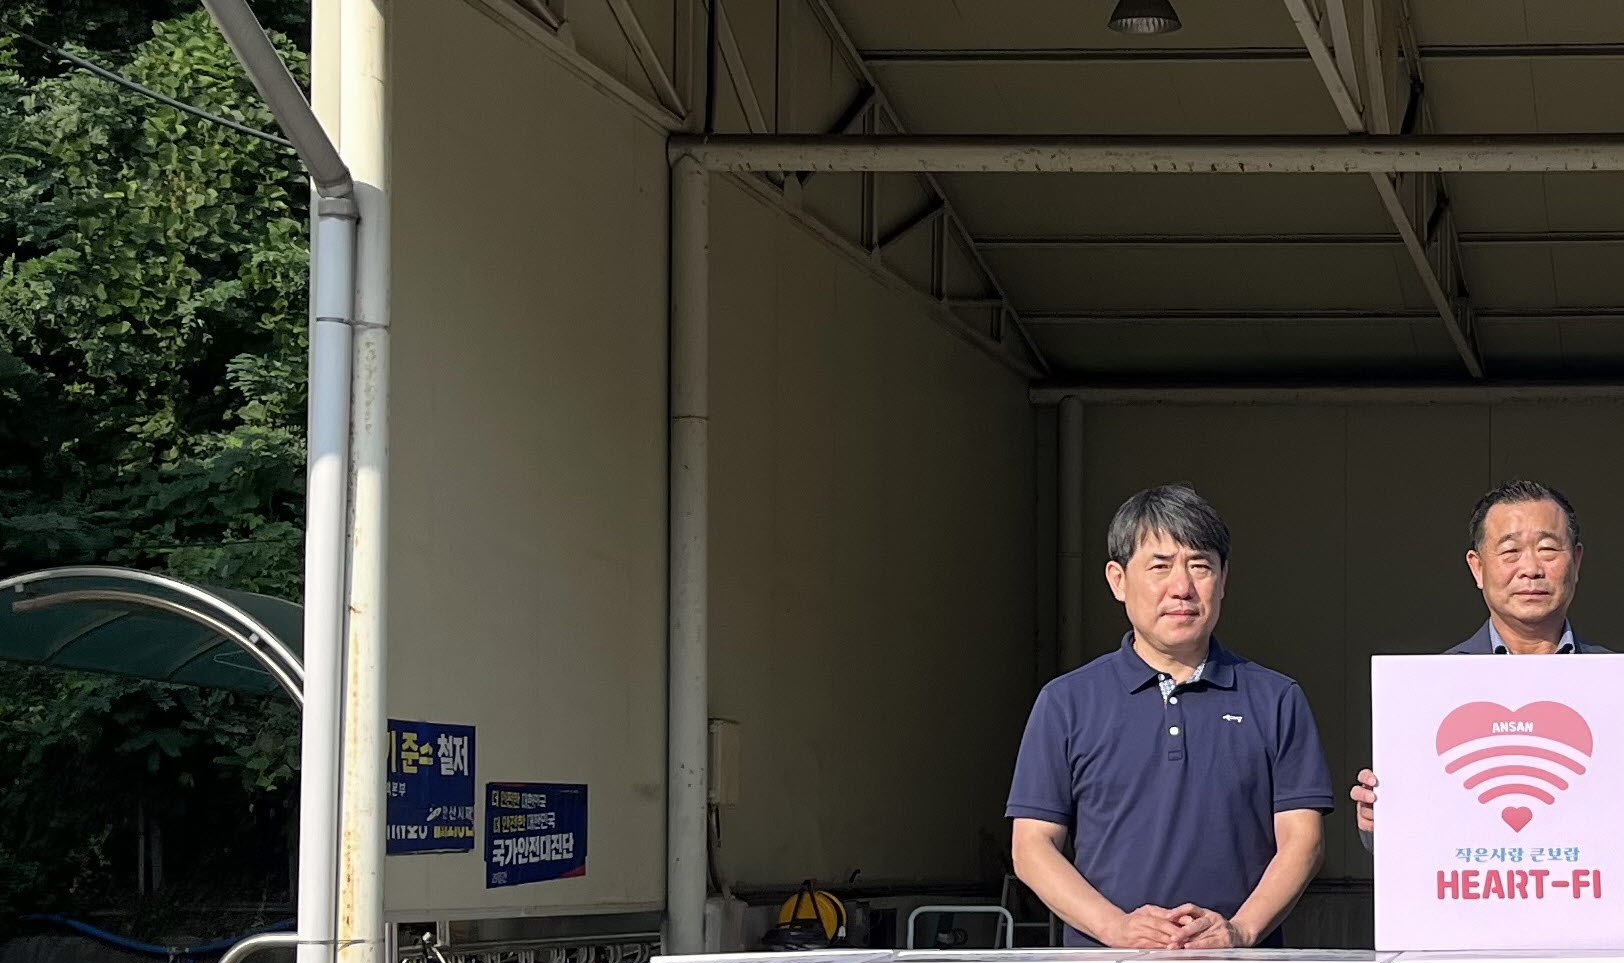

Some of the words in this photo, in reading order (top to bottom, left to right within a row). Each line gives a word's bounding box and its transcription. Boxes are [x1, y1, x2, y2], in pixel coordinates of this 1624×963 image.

[1492, 720, 1533, 734] ANSAN
[438, 734, 468, 776] 철저
[502, 814, 526, 832] 안전한
[492, 832, 574, 866] 국가안전대진단
[1455, 846, 1524, 864] 작은사랑
[1529, 846, 1580, 863] 큰보람
[1436, 870, 1602, 900] HEART-FI
